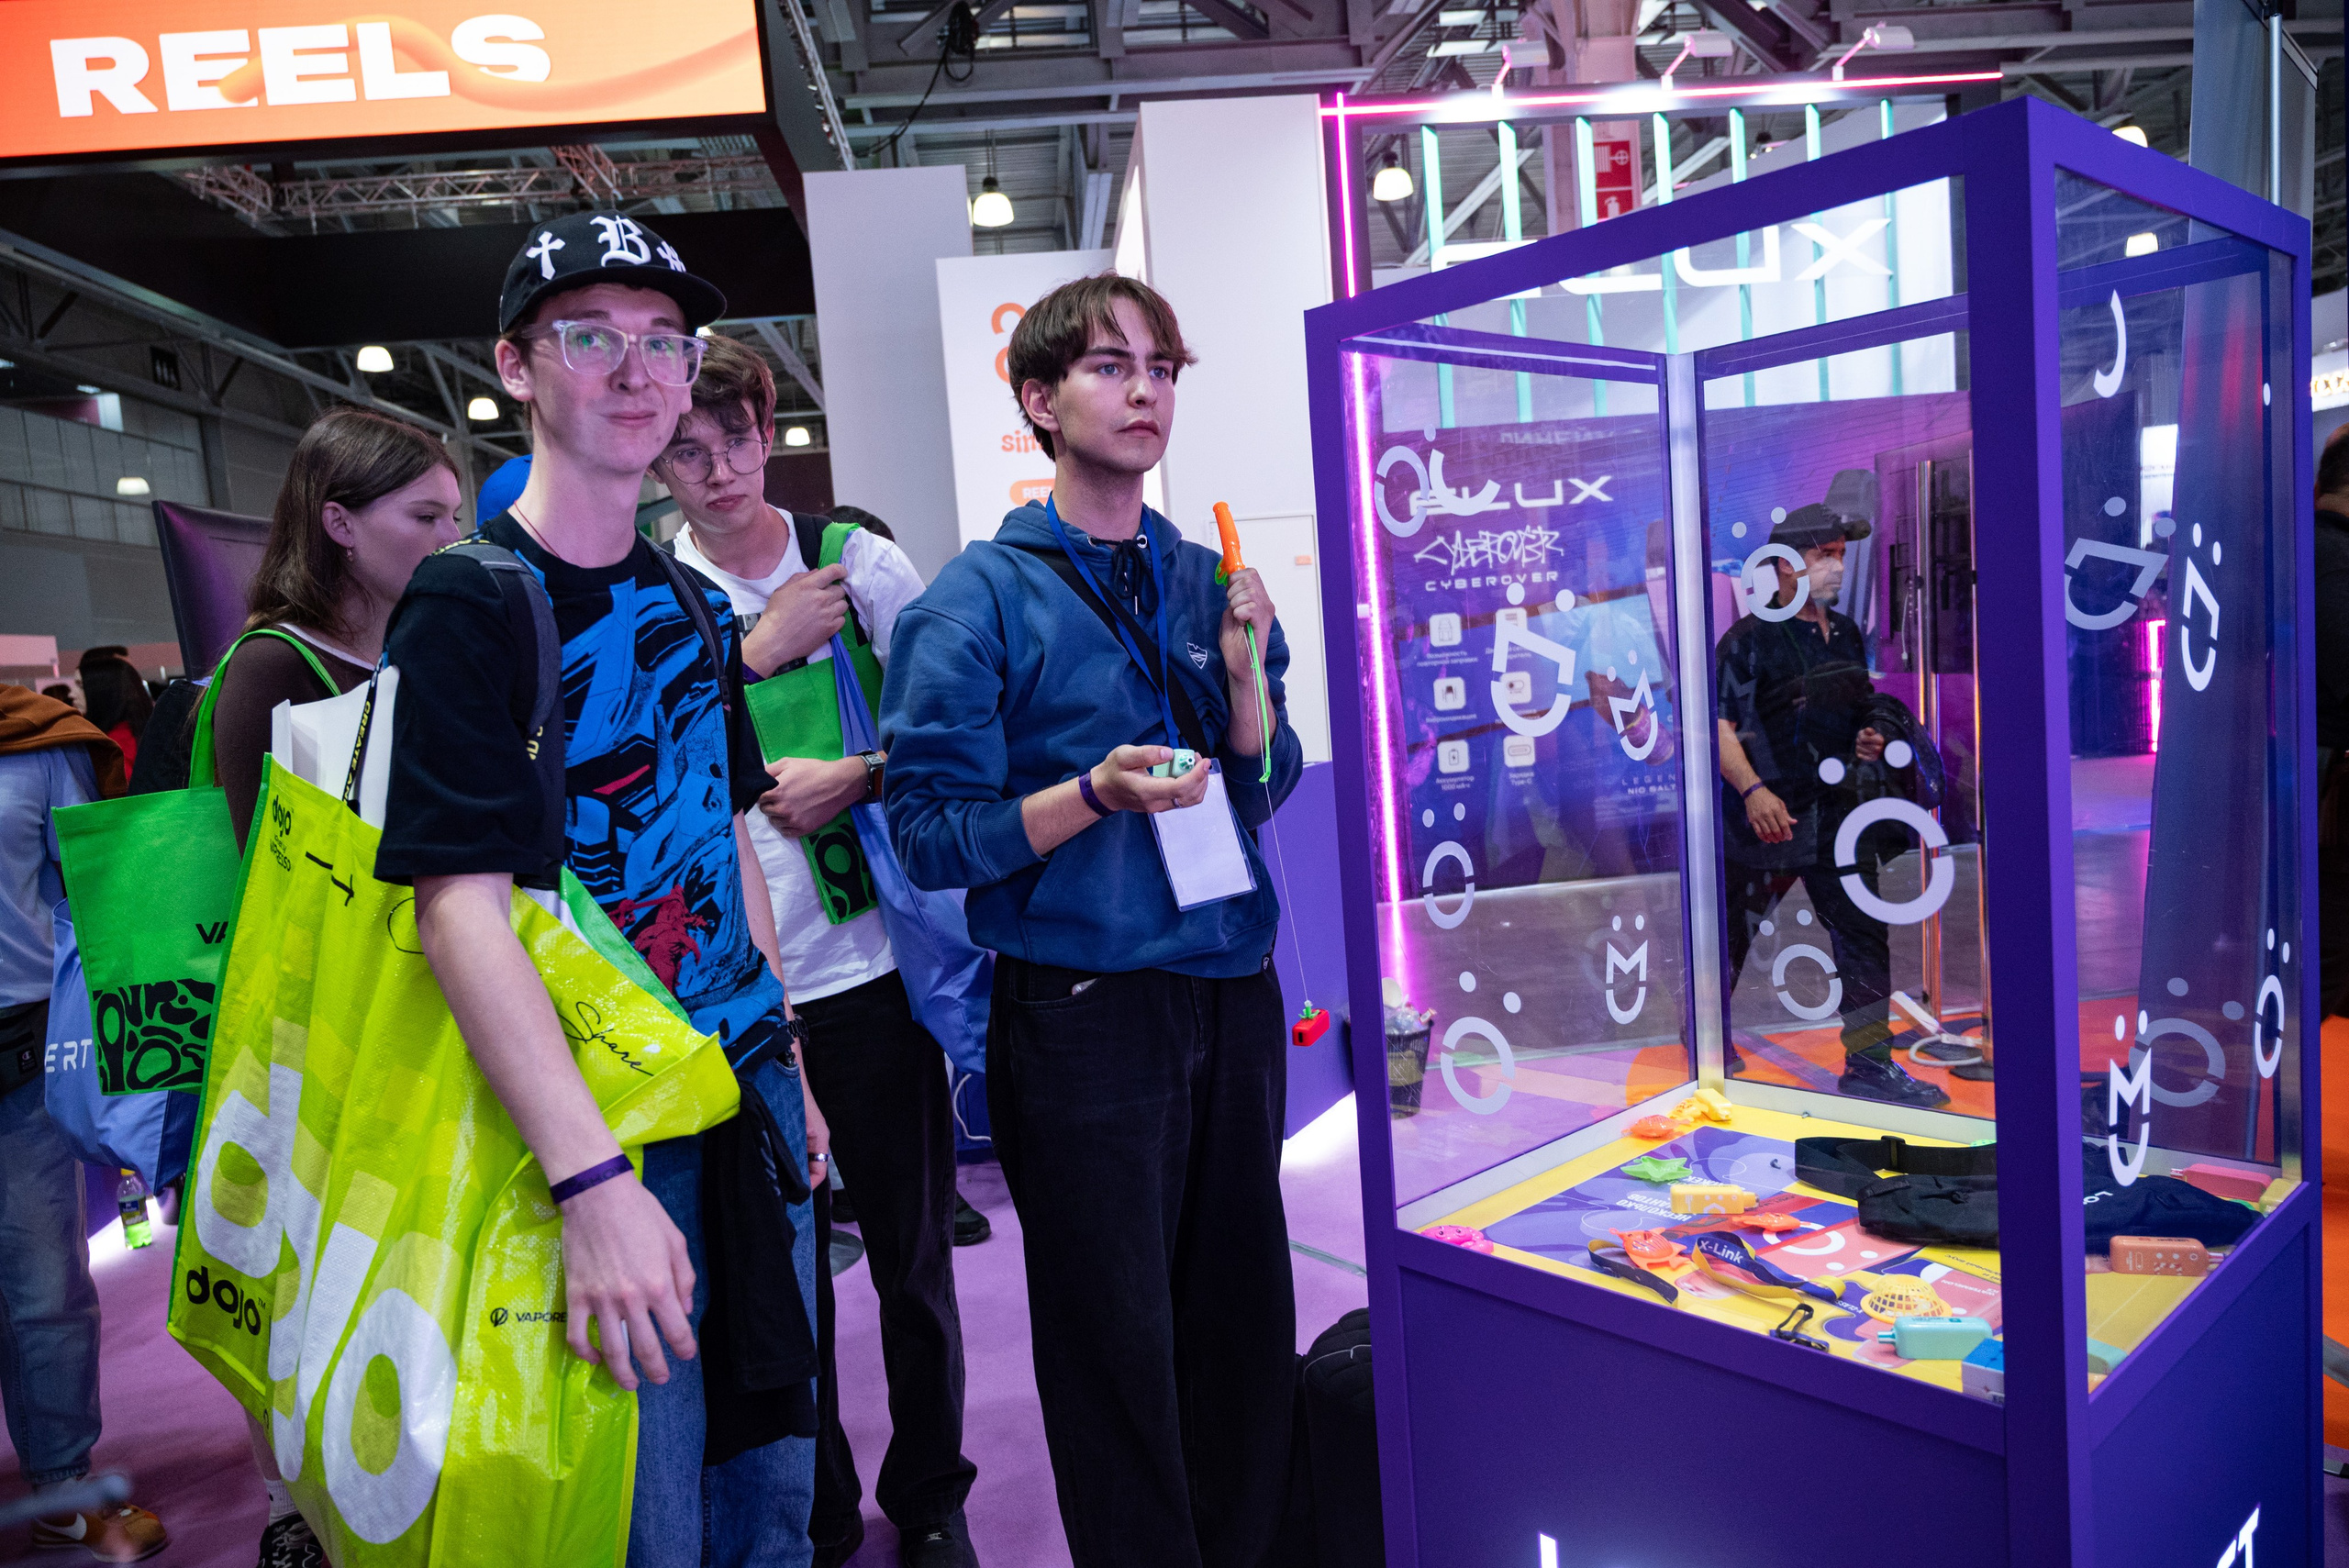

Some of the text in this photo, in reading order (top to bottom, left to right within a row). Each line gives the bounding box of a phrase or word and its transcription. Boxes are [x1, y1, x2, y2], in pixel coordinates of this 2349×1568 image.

[50, 14, 551, 117] REELS
[1001, 430, 1043, 452] sim
[1425, 571, 1559, 592] CYBEROVER
[1621, 773, 1675, 785] LEGEN
[1616, 1199, 1692, 1222] НЕСКОЛЬКО
[1699, 1240, 1743, 1264] X-Link
[186, 1265, 262, 1336] dojo
[516, 1311, 567, 1323] VAPORE
